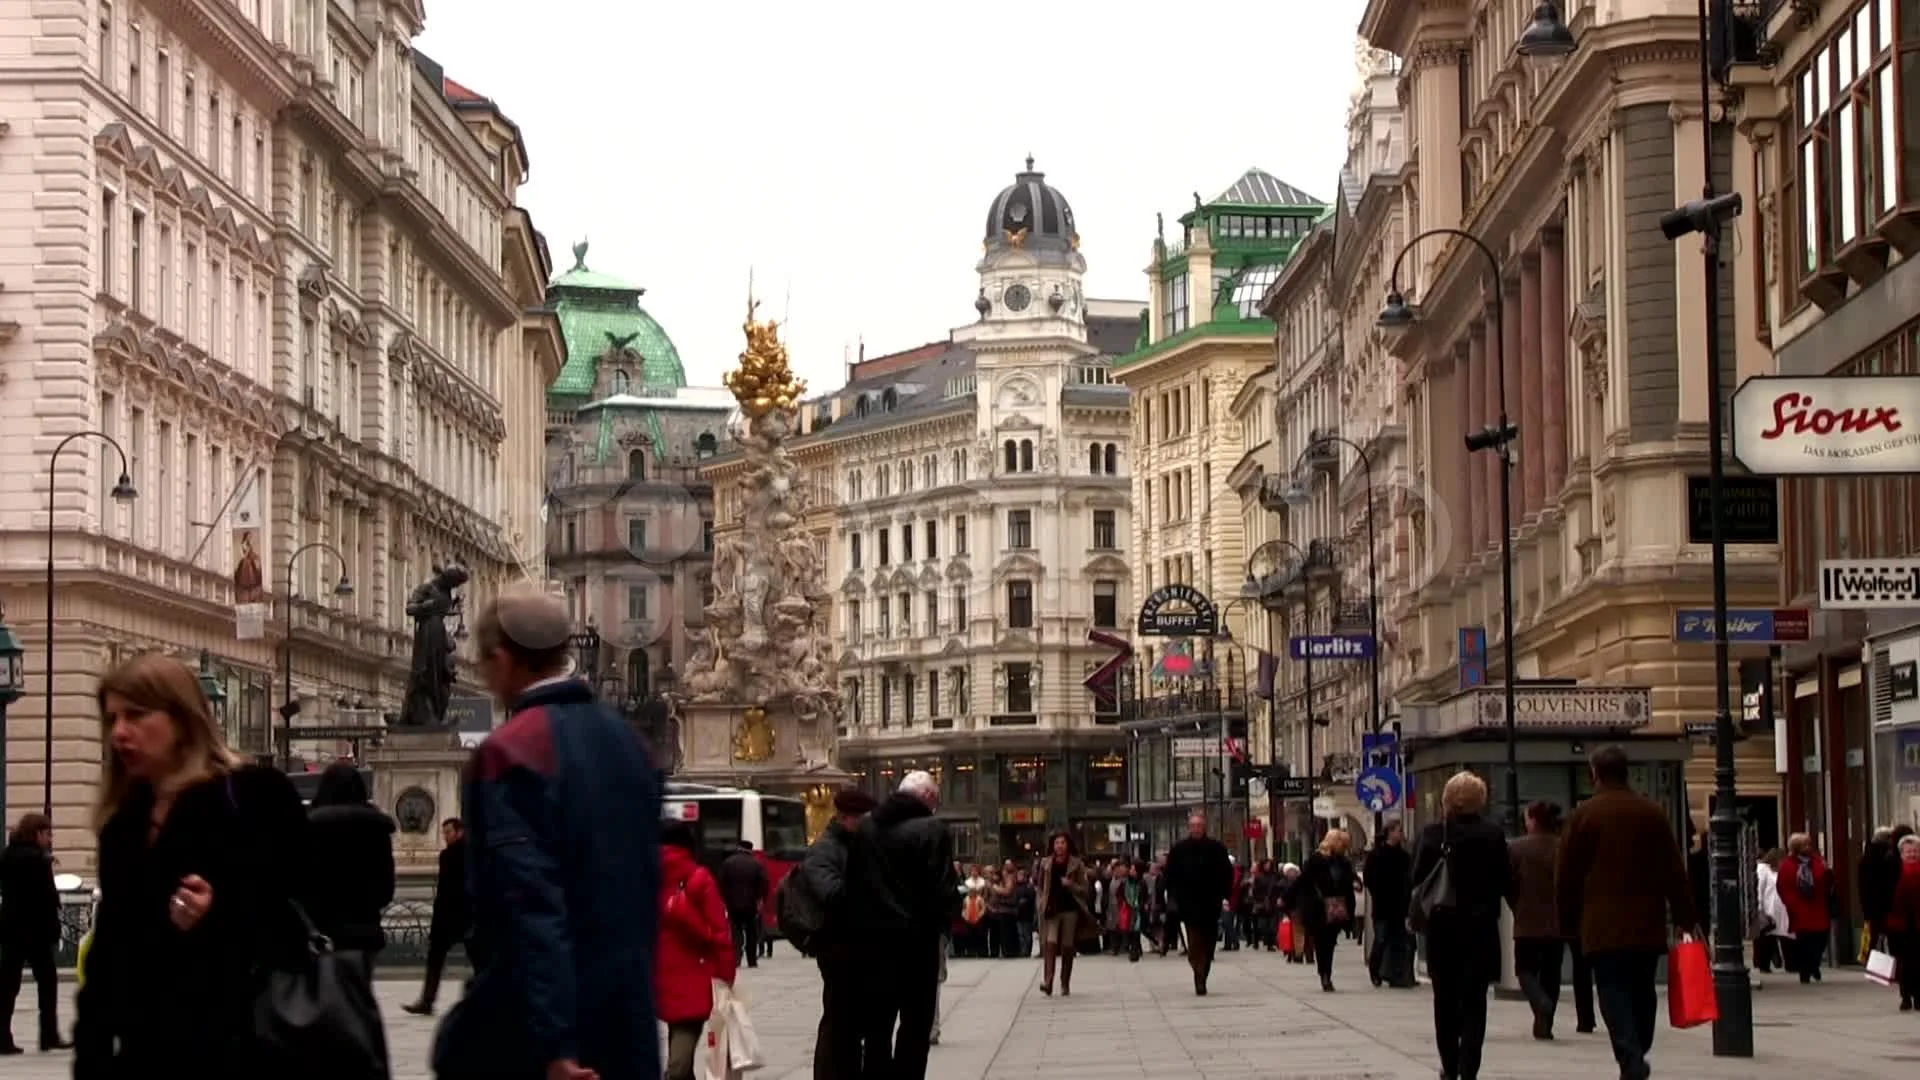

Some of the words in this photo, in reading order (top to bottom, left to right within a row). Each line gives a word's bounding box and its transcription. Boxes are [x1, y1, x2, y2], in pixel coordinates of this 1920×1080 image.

[1761, 392, 1902, 439] Sioux
[1842, 575, 1912, 593] Wolford
[1156, 616, 1198, 626] BUFFET
[1300, 637, 1363, 655] Berlitz
[1513, 697, 1620, 713] OUVENIRS
